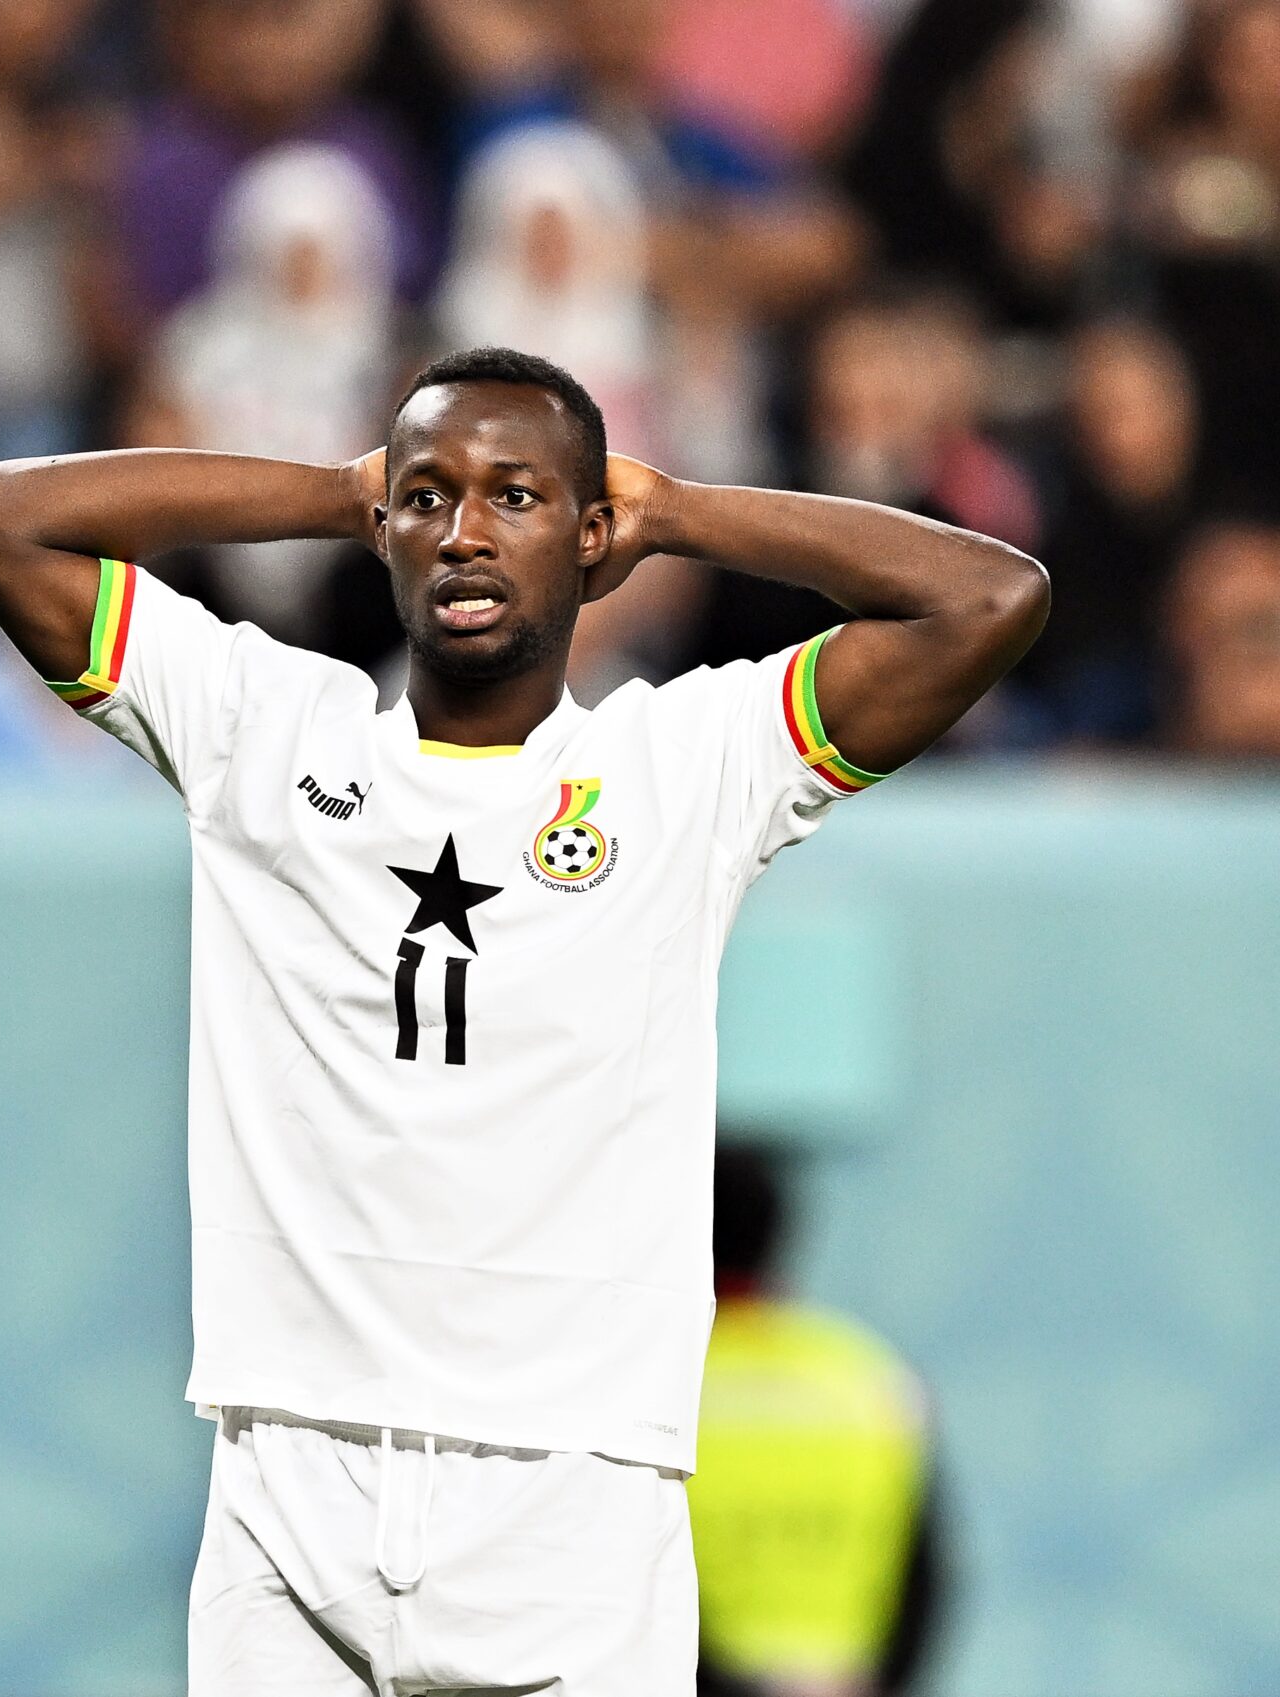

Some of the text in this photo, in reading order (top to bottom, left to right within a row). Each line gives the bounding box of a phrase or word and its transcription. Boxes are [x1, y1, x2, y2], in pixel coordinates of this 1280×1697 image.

[297, 775, 356, 820] PUMA
[522, 837, 619, 893] GHANA FOOTBALL ASSOCIATION
[394, 937, 472, 1066] 11
